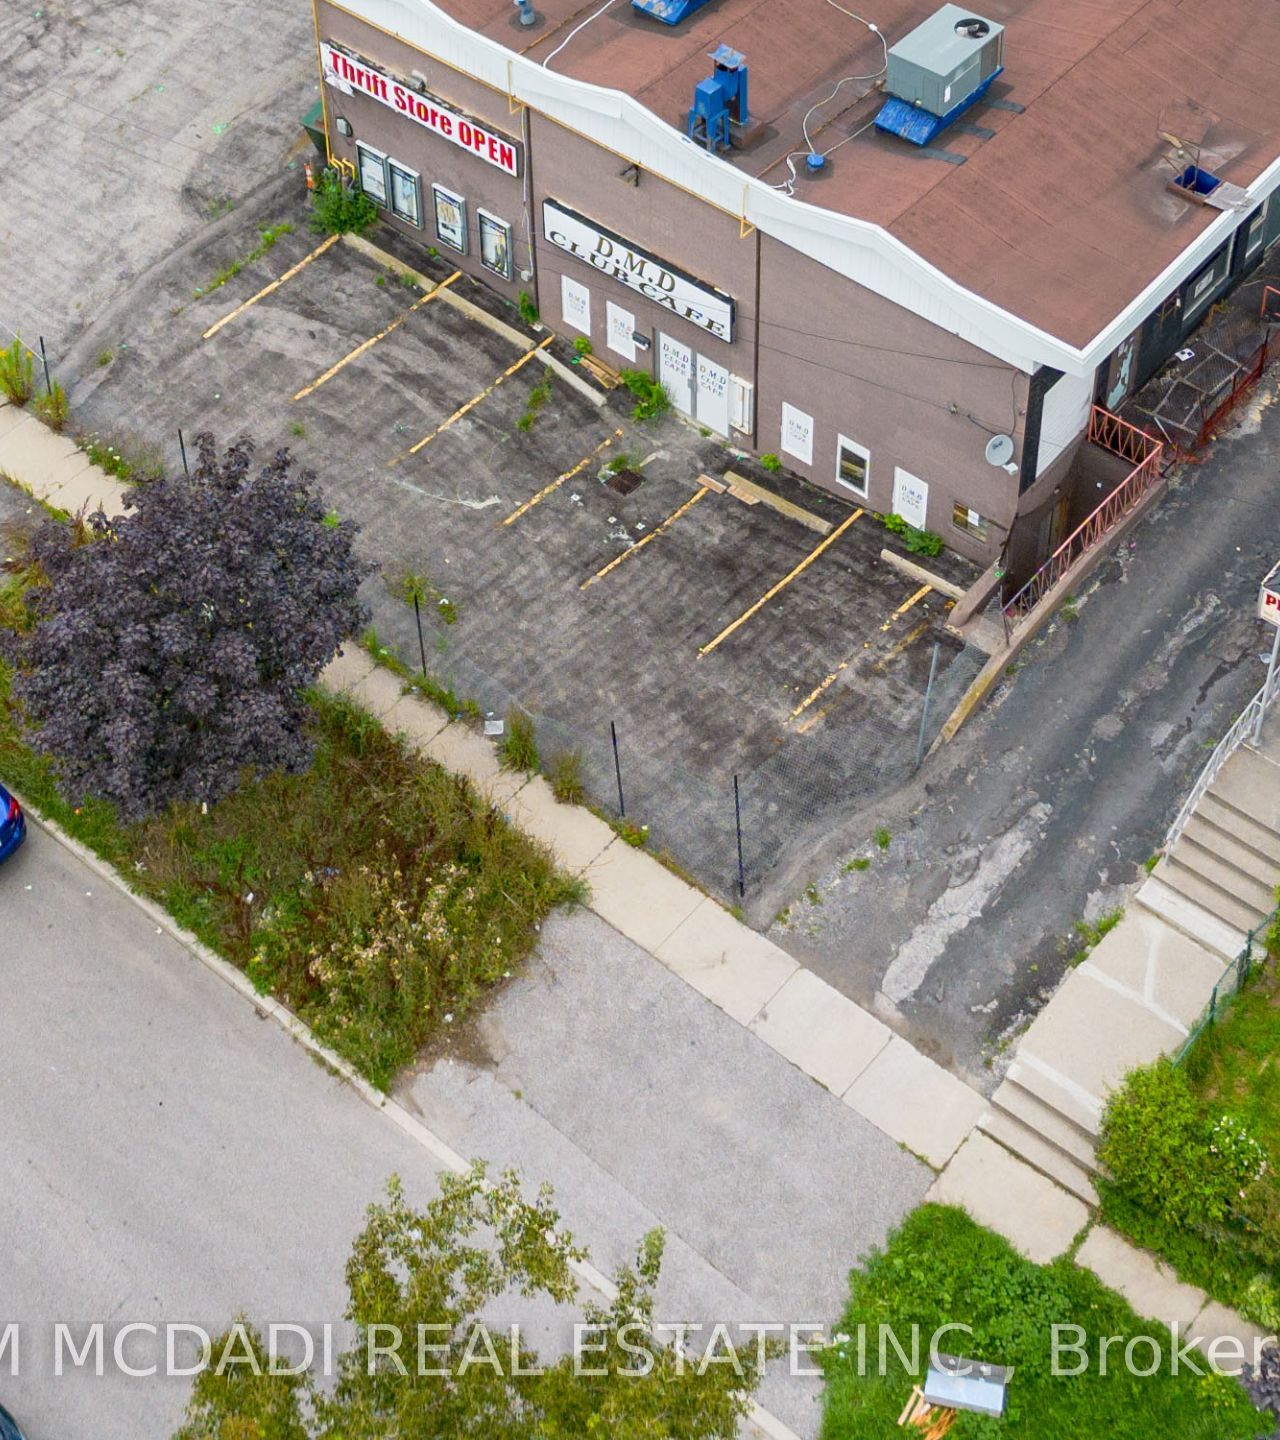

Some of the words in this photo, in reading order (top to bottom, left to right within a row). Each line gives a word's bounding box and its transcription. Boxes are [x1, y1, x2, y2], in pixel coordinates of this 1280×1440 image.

[329, 50, 389, 102] Thrift
[393, 85, 453, 136] Store
[458, 121, 513, 171] OPEN
[550, 230, 629, 283] CLUB
[639, 282, 725, 337] CAFE
[594, 234, 676, 293] D.M.D
